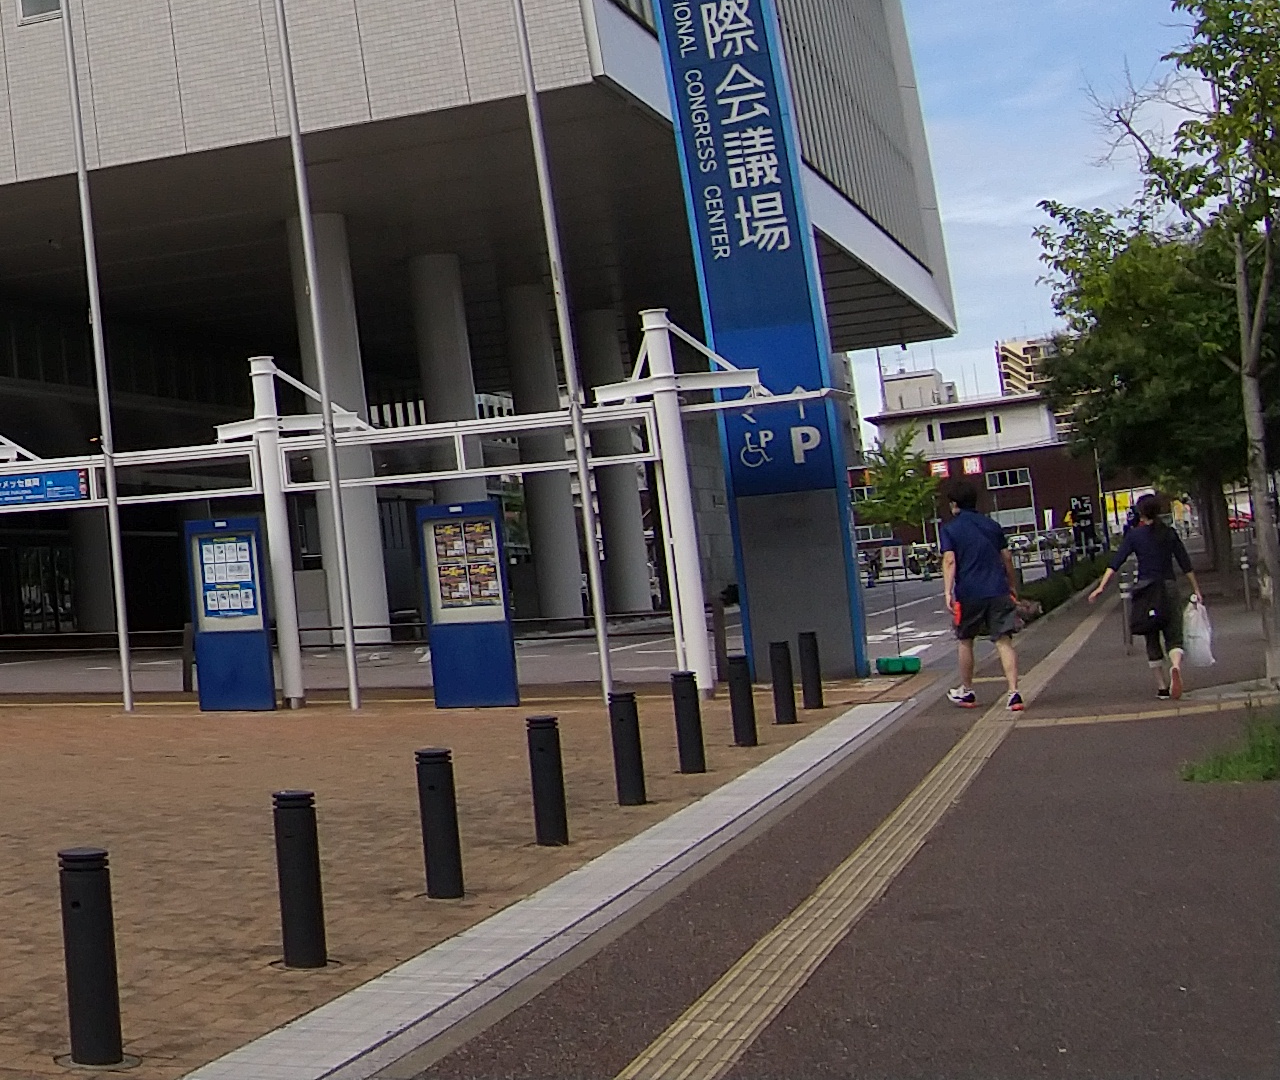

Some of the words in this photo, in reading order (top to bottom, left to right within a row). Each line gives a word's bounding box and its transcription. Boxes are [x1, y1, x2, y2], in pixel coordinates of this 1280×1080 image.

[684, 69, 719, 173] CONGRESS
[703, 185, 731, 260] CENTER
[790, 425, 821, 464] P
